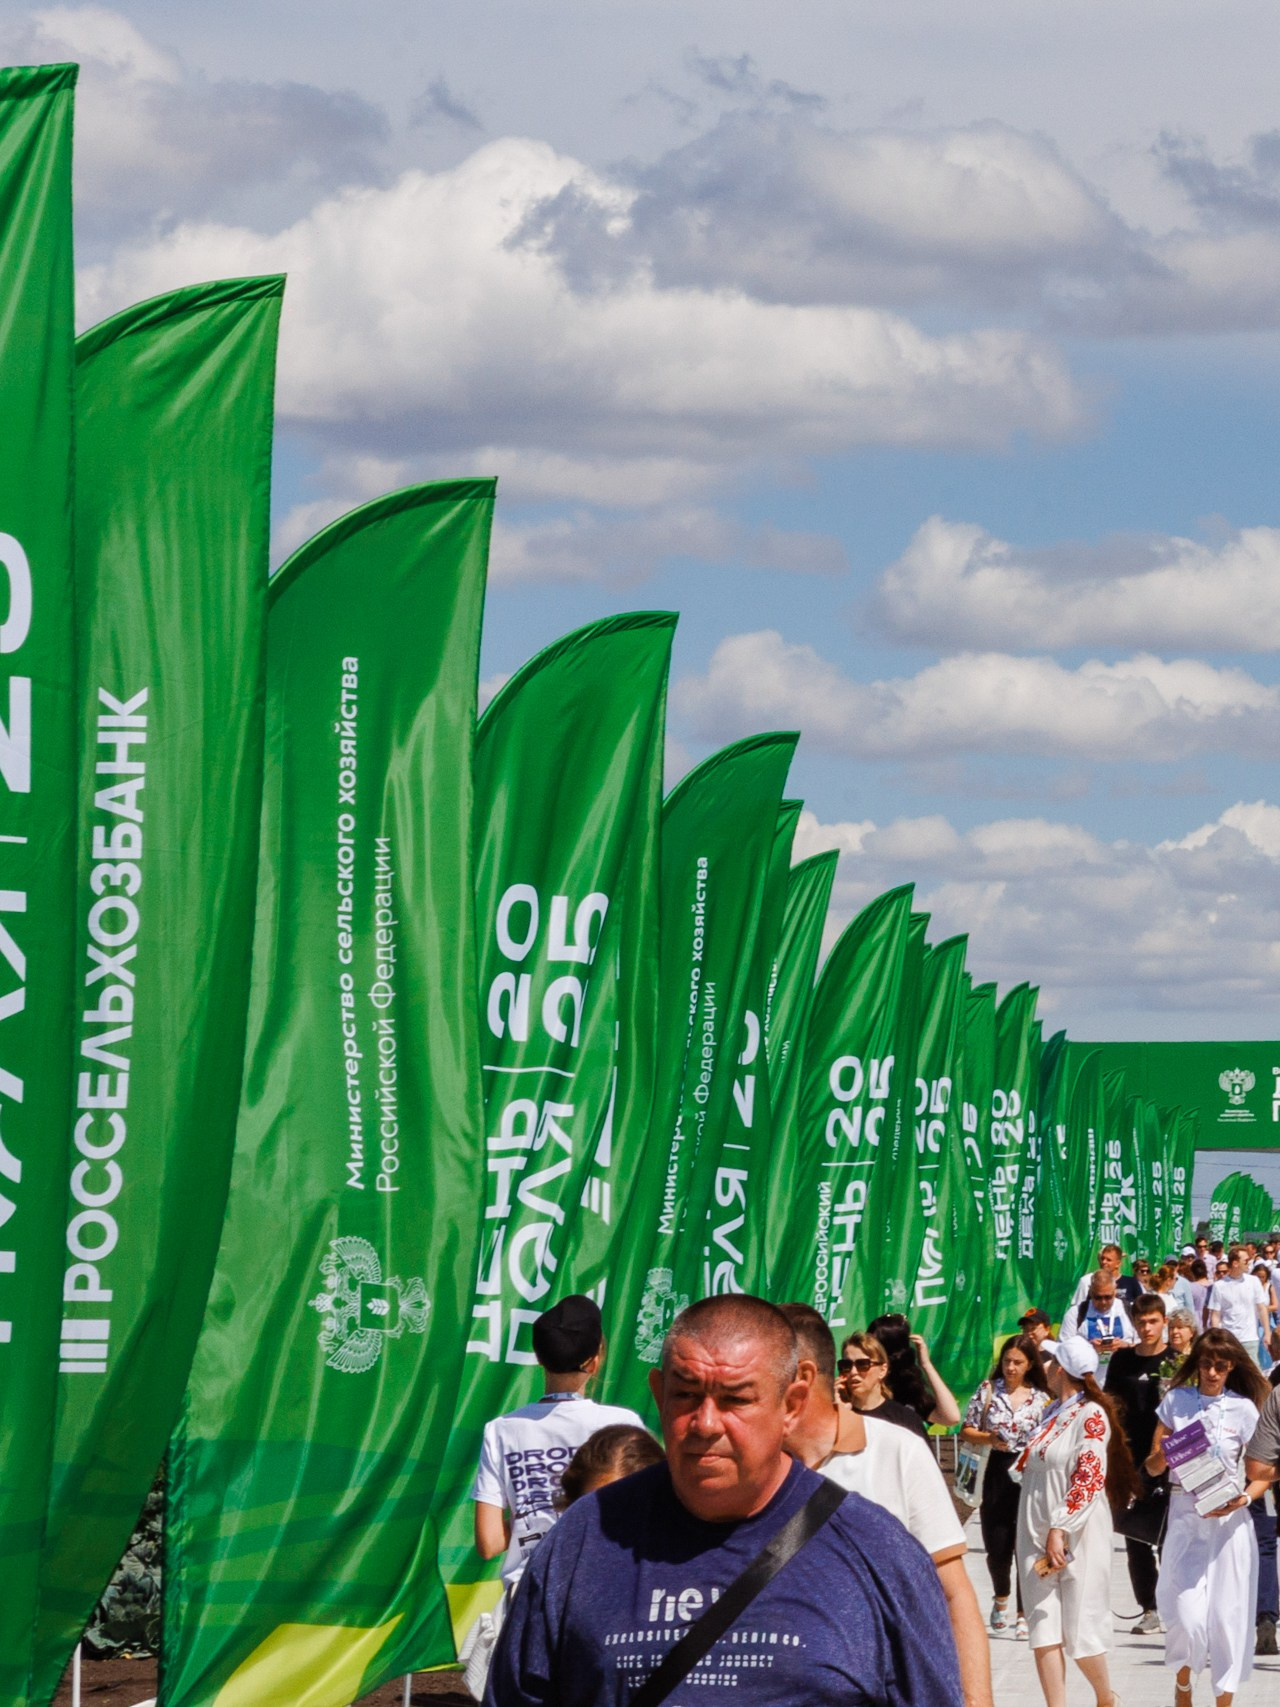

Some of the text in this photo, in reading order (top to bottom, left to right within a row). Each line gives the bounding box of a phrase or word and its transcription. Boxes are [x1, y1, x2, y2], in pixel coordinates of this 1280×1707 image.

[334, 656, 364, 1190] Министерство сельского хозяйства
[487, 883, 540, 1042] 20
[542, 892, 609, 1048] 25
[691, 856, 708, 962] хозяйства
[64, 686, 148, 1302] РОССЕЛЬХОЗБАНК
[366, 836, 400, 1193] Российской Федерации
[693, 981, 717, 1104] Федерации
[825, 1055, 864, 1148] 20
[1108, 1139, 1122, 1179] 25
[1151, 1161, 1163, 1196] 25
[1173, 1166, 1186, 1196] 25
